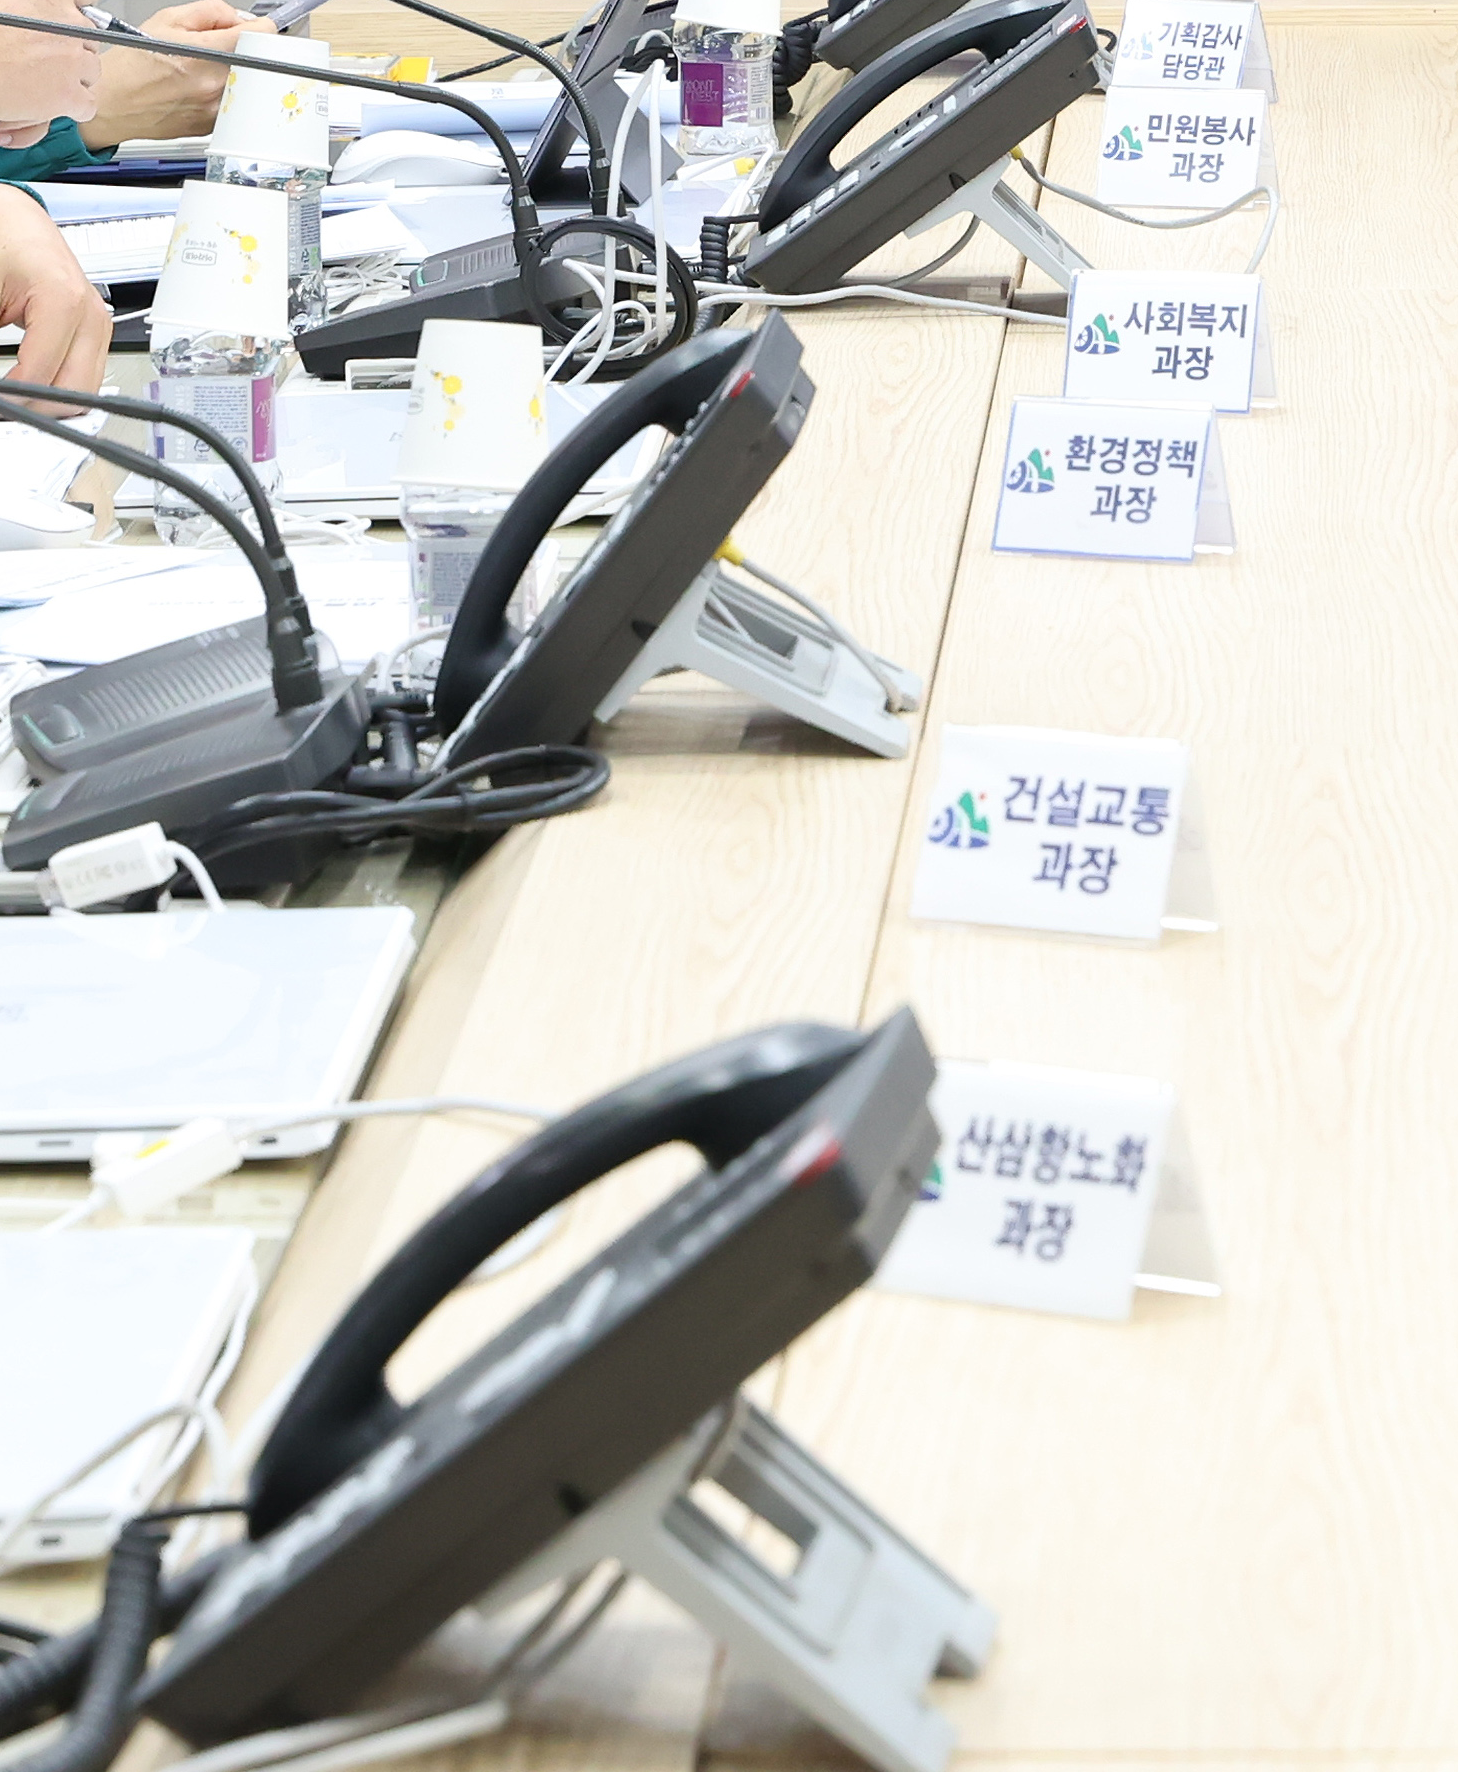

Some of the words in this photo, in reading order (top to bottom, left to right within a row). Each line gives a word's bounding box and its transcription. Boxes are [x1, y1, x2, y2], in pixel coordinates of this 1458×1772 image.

[1157, 21, 1243, 51] 기획감사
[1161, 53, 1225, 81] 담당관
[1146, 114, 1256, 146] 민원봉사
[1169, 152, 1225, 183] 과장
[1123, 300, 1249, 339] 사회복지
[1151, 344, 1214, 381] 과장
[1065, 434, 1198, 478] 환경정책
[1090, 484, 1157, 524] 과장
[1002, 775, 1172, 837] 건설교통
[1031, 841, 1119, 895] 과장
[954, 1113, 1148, 1194] 산삼항노화
[994, 1196, 1075, 1263] 과장
